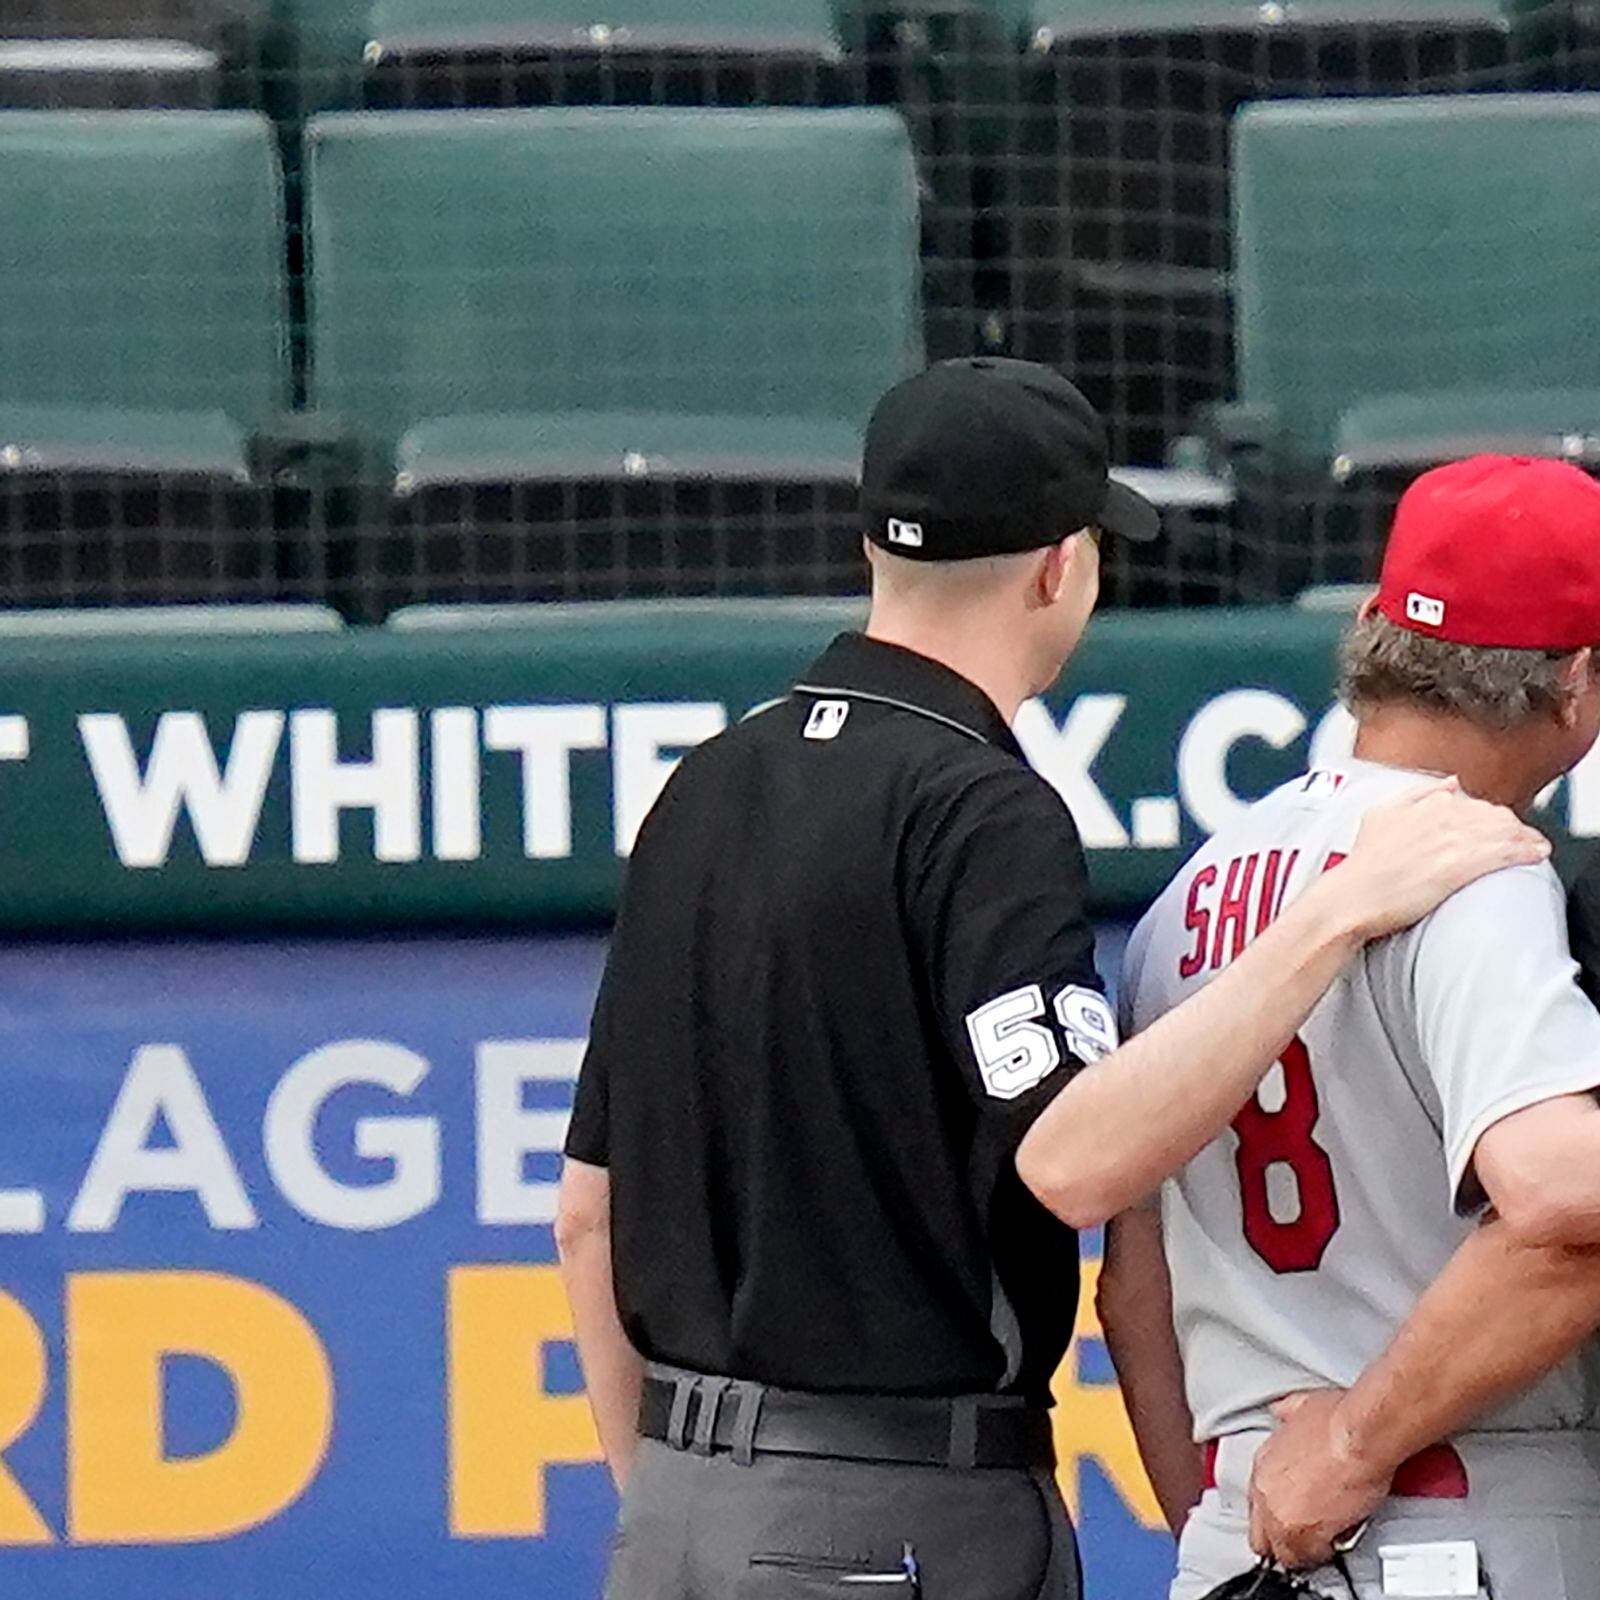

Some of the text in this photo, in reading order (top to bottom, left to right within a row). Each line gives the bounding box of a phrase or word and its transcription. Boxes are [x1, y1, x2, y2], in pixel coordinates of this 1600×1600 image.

[0, 1038, 589, 1233] AGE
[1229, 1031, 1341, 1275] 8
[0, 1270, 335, 1547] D
